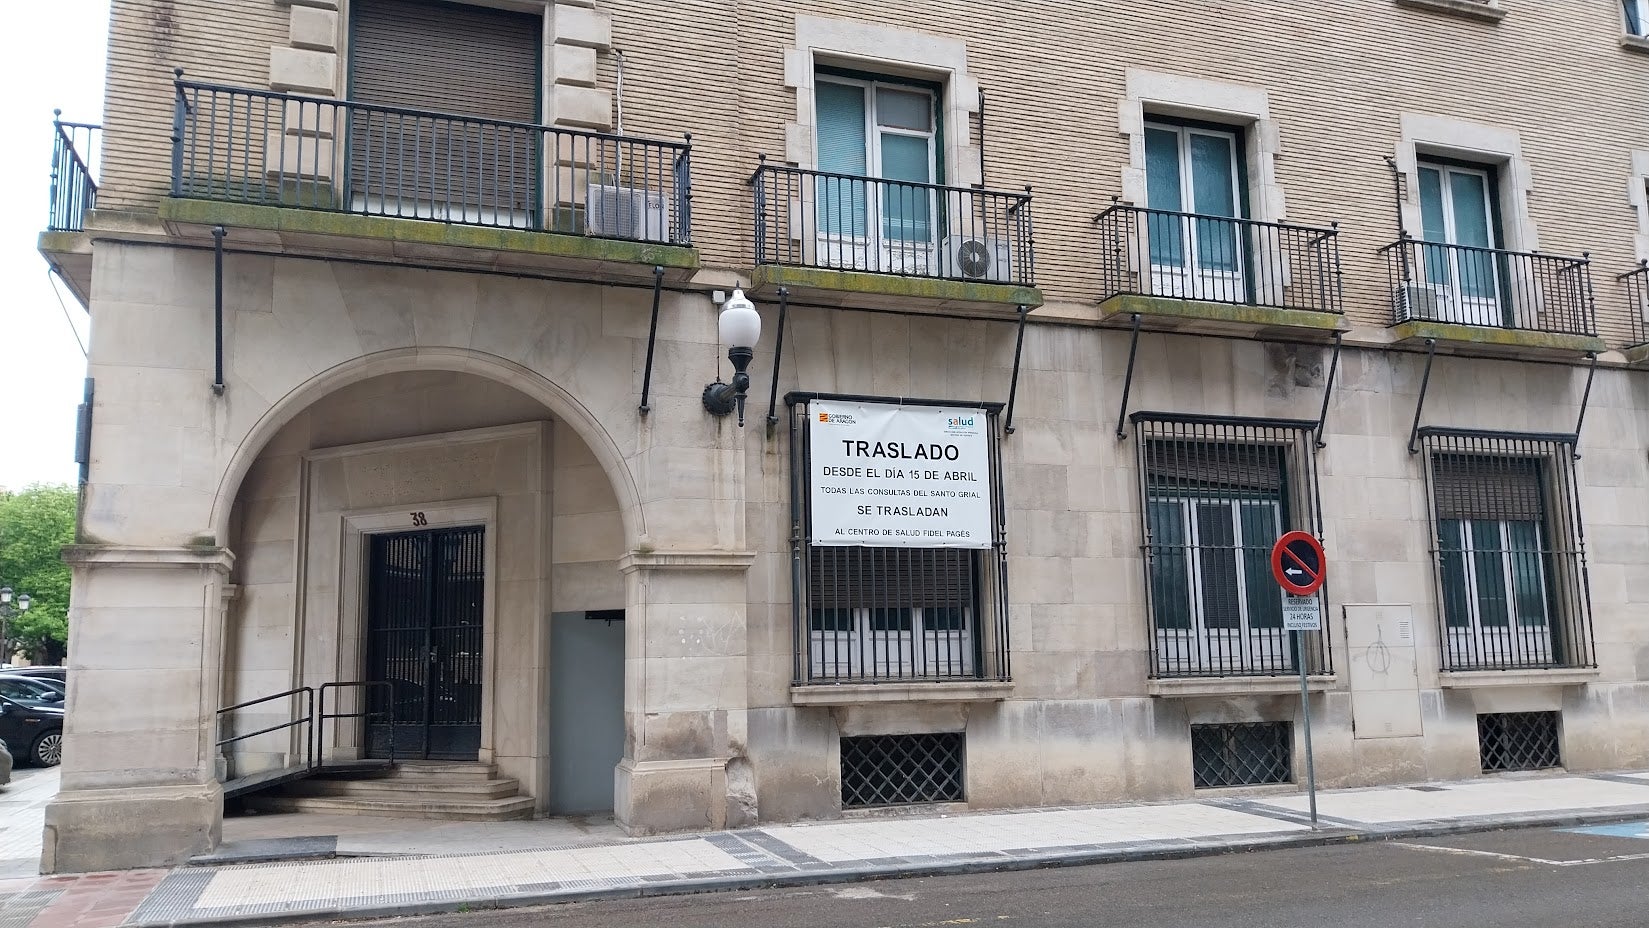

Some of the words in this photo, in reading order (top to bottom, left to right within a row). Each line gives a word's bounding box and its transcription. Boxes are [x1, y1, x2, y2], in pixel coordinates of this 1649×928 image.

[948, 416, 974, 426] salud
[842, 440, 959, 461] TRASLADO
[823, 467, 861, 477] DESDE
[867, 469, 880, 478] EL
[886, 467, 904, 479] DÍA
[909, 470, 919, 479] 15
[925, 471, 939, 480] DE
[944, 472, 977, 481] ABRIL
[868, 488, 910, 496] CONSULTAS
[931, 490, 955, 498] SANTO
[858, 505, 872, 515] SE
[877, 506, 948, 517] TRASLADAN
[410, 512, 427, 526] 38
